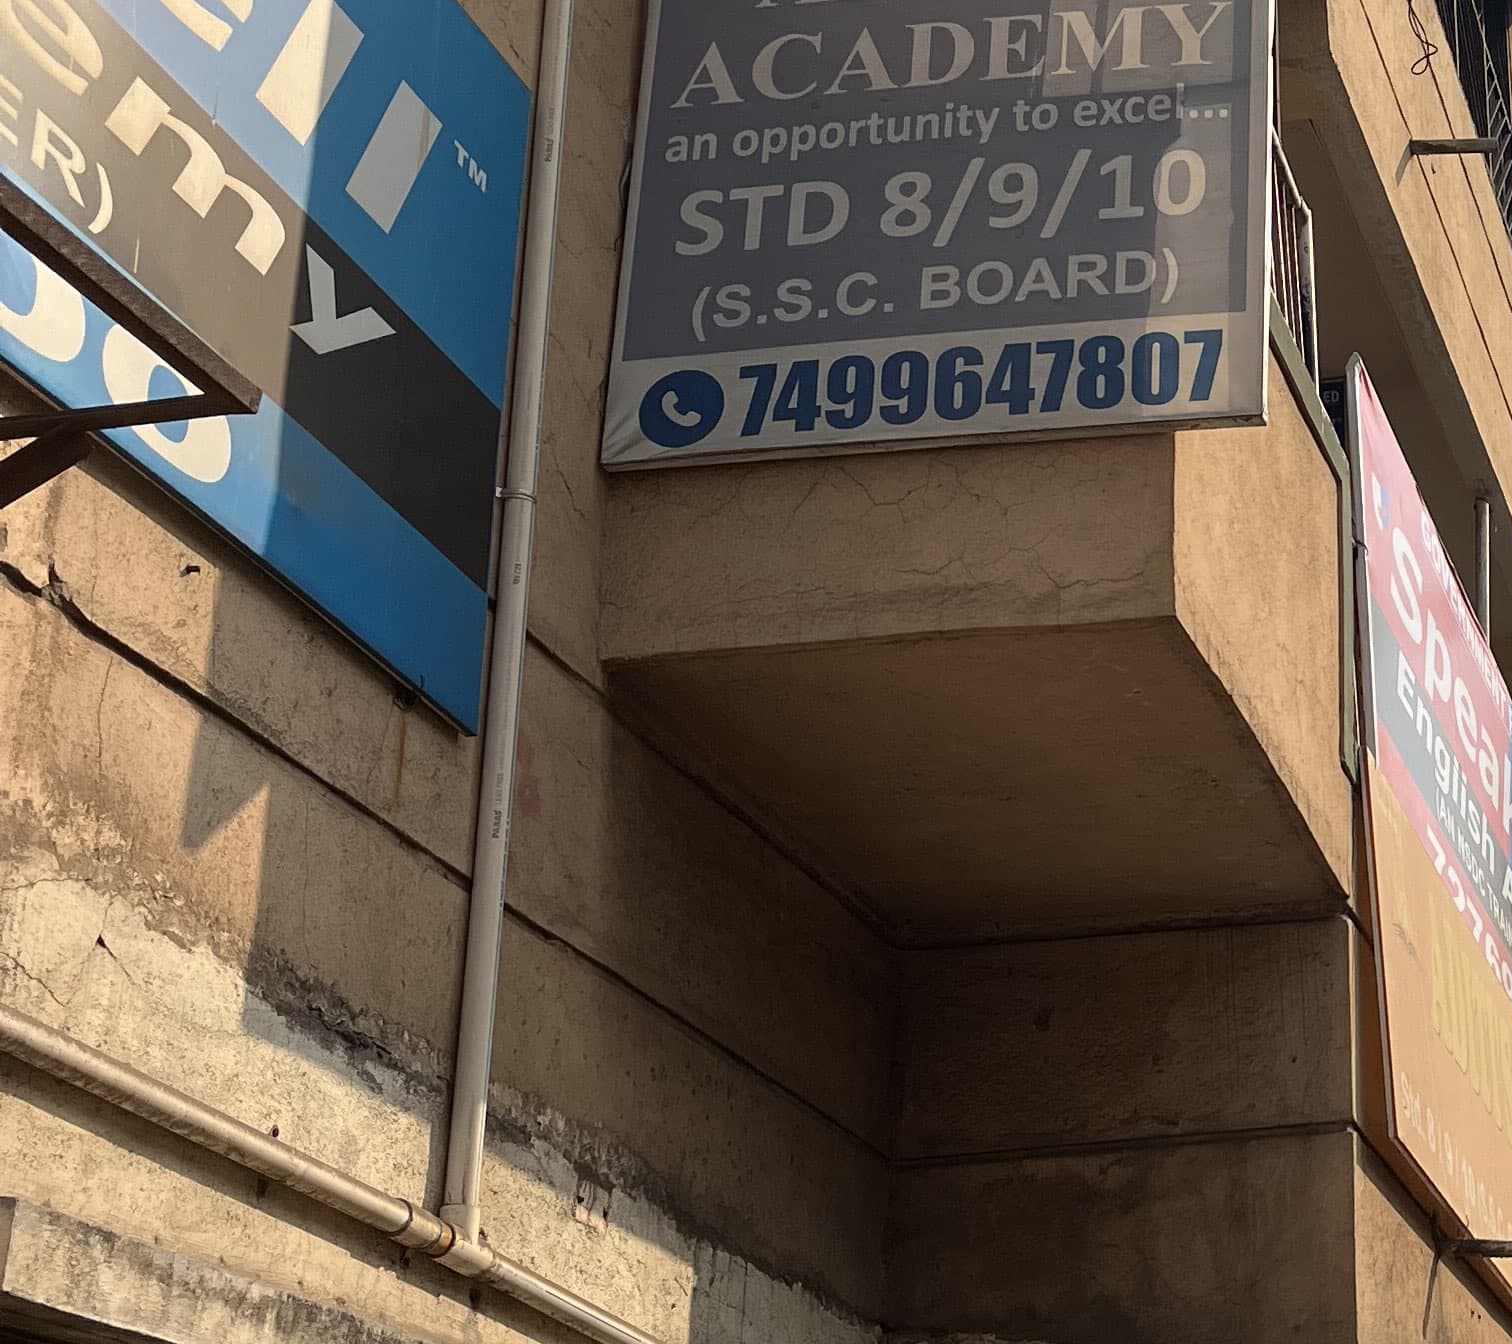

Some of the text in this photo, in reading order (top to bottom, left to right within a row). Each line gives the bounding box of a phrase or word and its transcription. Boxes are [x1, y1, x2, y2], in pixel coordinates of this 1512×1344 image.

[670, 0, 1233, 110] ACADEMY
[665, 128, 718, 163] an
[732, 97, 999, 164] opportunity
[1013, 98, 1059, 132] to
[674, 148, 1208, 256] STD 8/9/10
[691, 247, 1180, 343] (S.S.C. BOARD)
[738, 329, 1225, 439] 7499647807
[1420, 511, 1508, 718] GOVERNMENT
[1396, 650, 1495, 875] English
